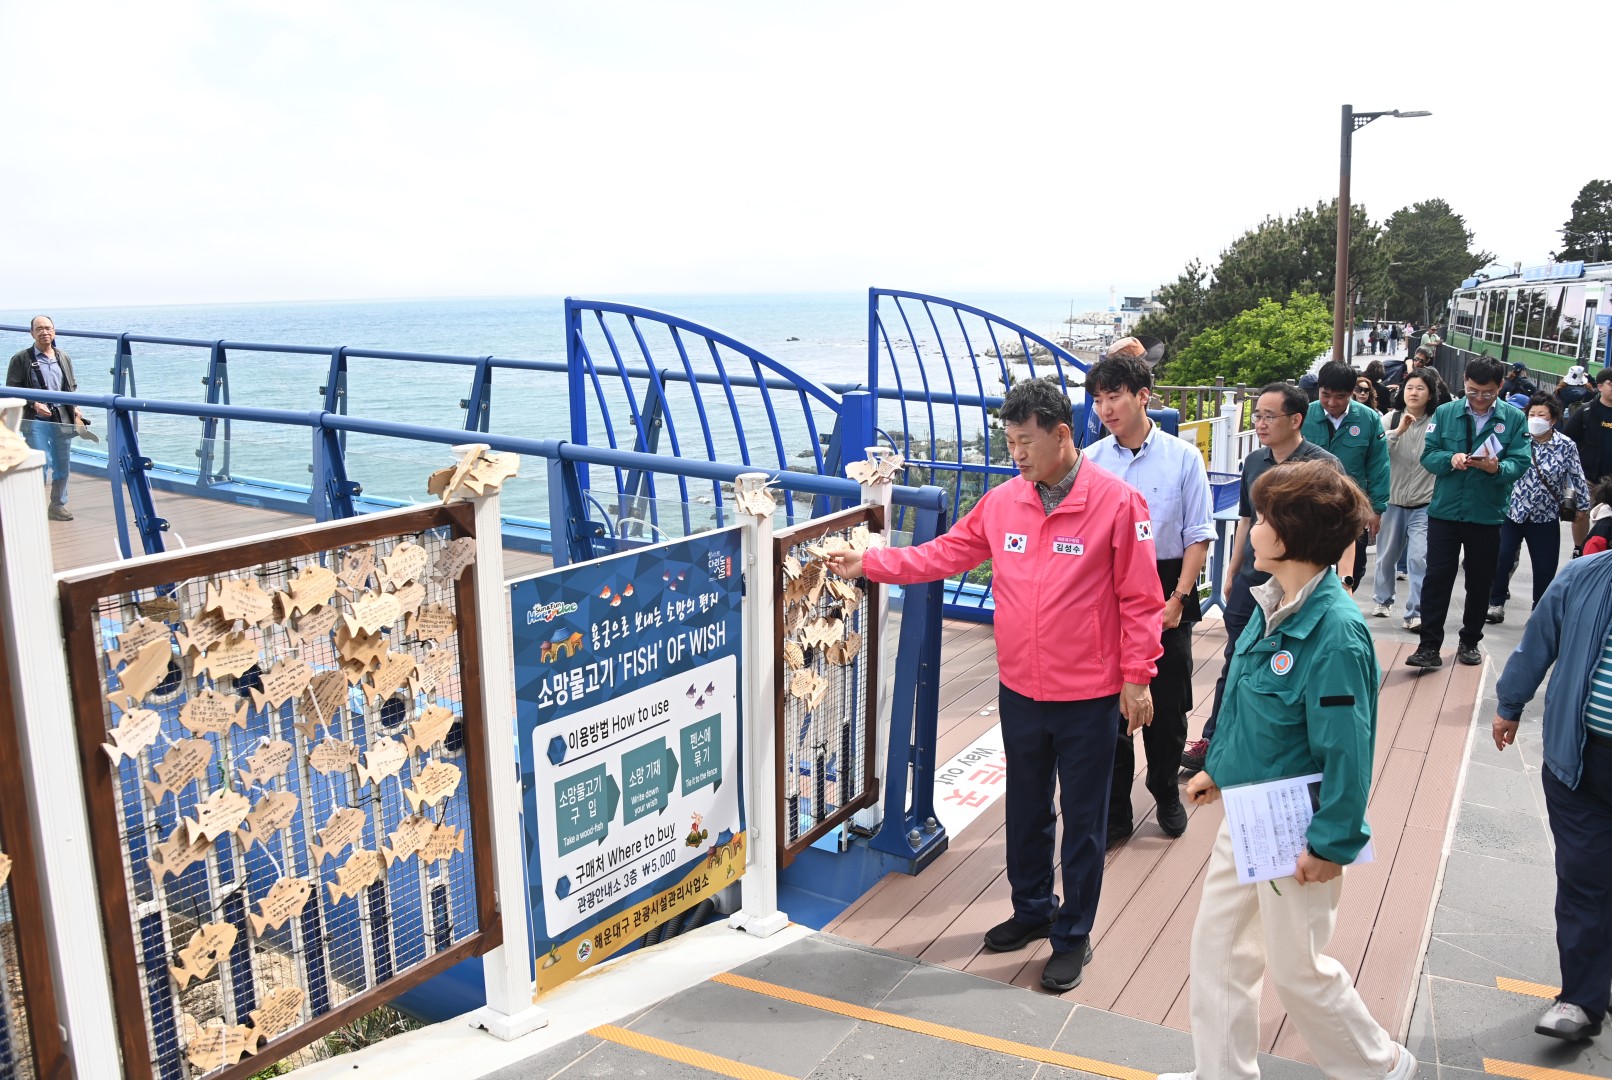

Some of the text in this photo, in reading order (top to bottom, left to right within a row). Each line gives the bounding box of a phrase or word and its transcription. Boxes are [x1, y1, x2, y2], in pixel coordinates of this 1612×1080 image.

[1056, 543, 1080, 553] 김성수
[591, 592, 719, 651] 용궁으로 보내는 소망의 편지
[537, 620, 726, 709] 소망물고기 'FISH' OF WISH
[568, 699, 670, 750] 이용방법 How to use
[690, 726, 711, 750] 펜스에
[629, 758, 661, 788] 소망 기재
[957, 747, 997, 767] Way
[559, 774, 602, 809] 소망물고기
[630, 786, 660, 805] Write down
[634, 797, 658, 817] your wish
[563, 835, 576, 847] Take
[575, 833, 580, 842] a
[576, 823, 676, 884] 구매처 Where to buy
[577, 882, 621, 913] 관광안내소
[624, 871, 638, 888] 3층
[594, 873, 709, 948] 해운대구 관광시설관리사업소
